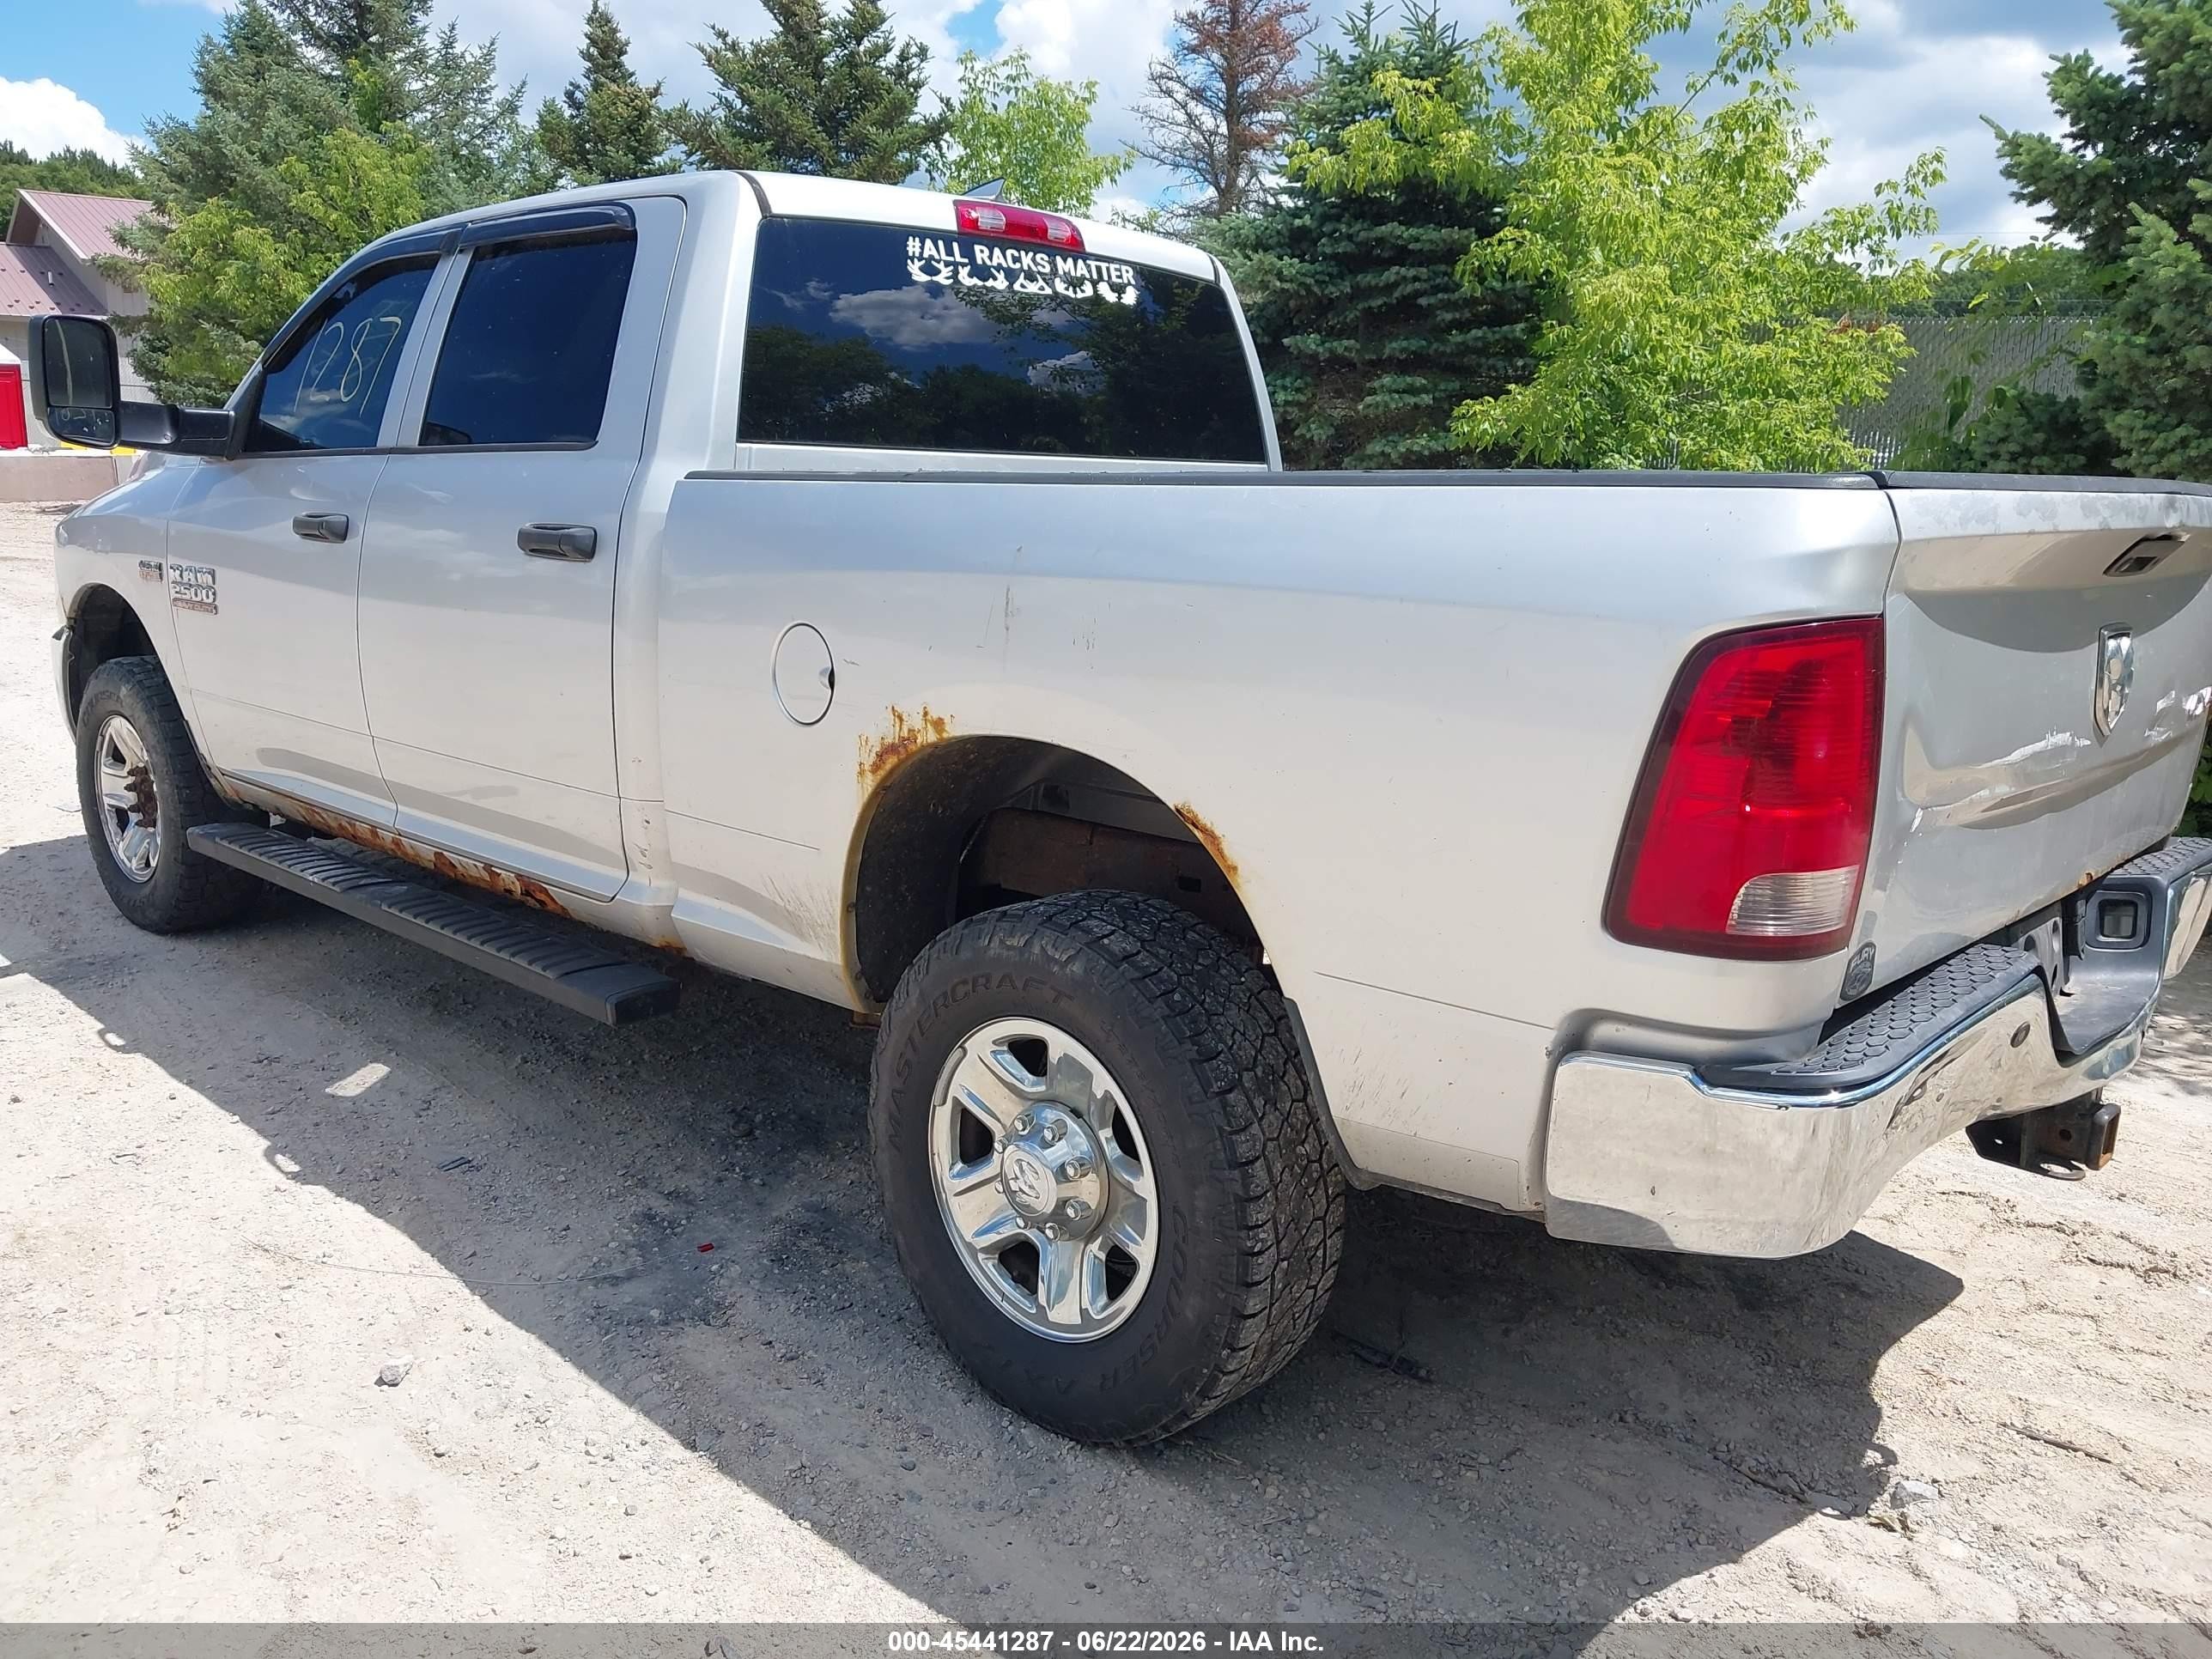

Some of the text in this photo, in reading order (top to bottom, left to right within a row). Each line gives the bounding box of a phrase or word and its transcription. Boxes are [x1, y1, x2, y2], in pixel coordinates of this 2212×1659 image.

[907, 235, 1136, 285] #ALL RACKS MATTER
[169, 563, 216, 586] RAM
[171, 581, 216, 603] 2500
[887, 971, 1075, 1152] MASTERCRAFT
